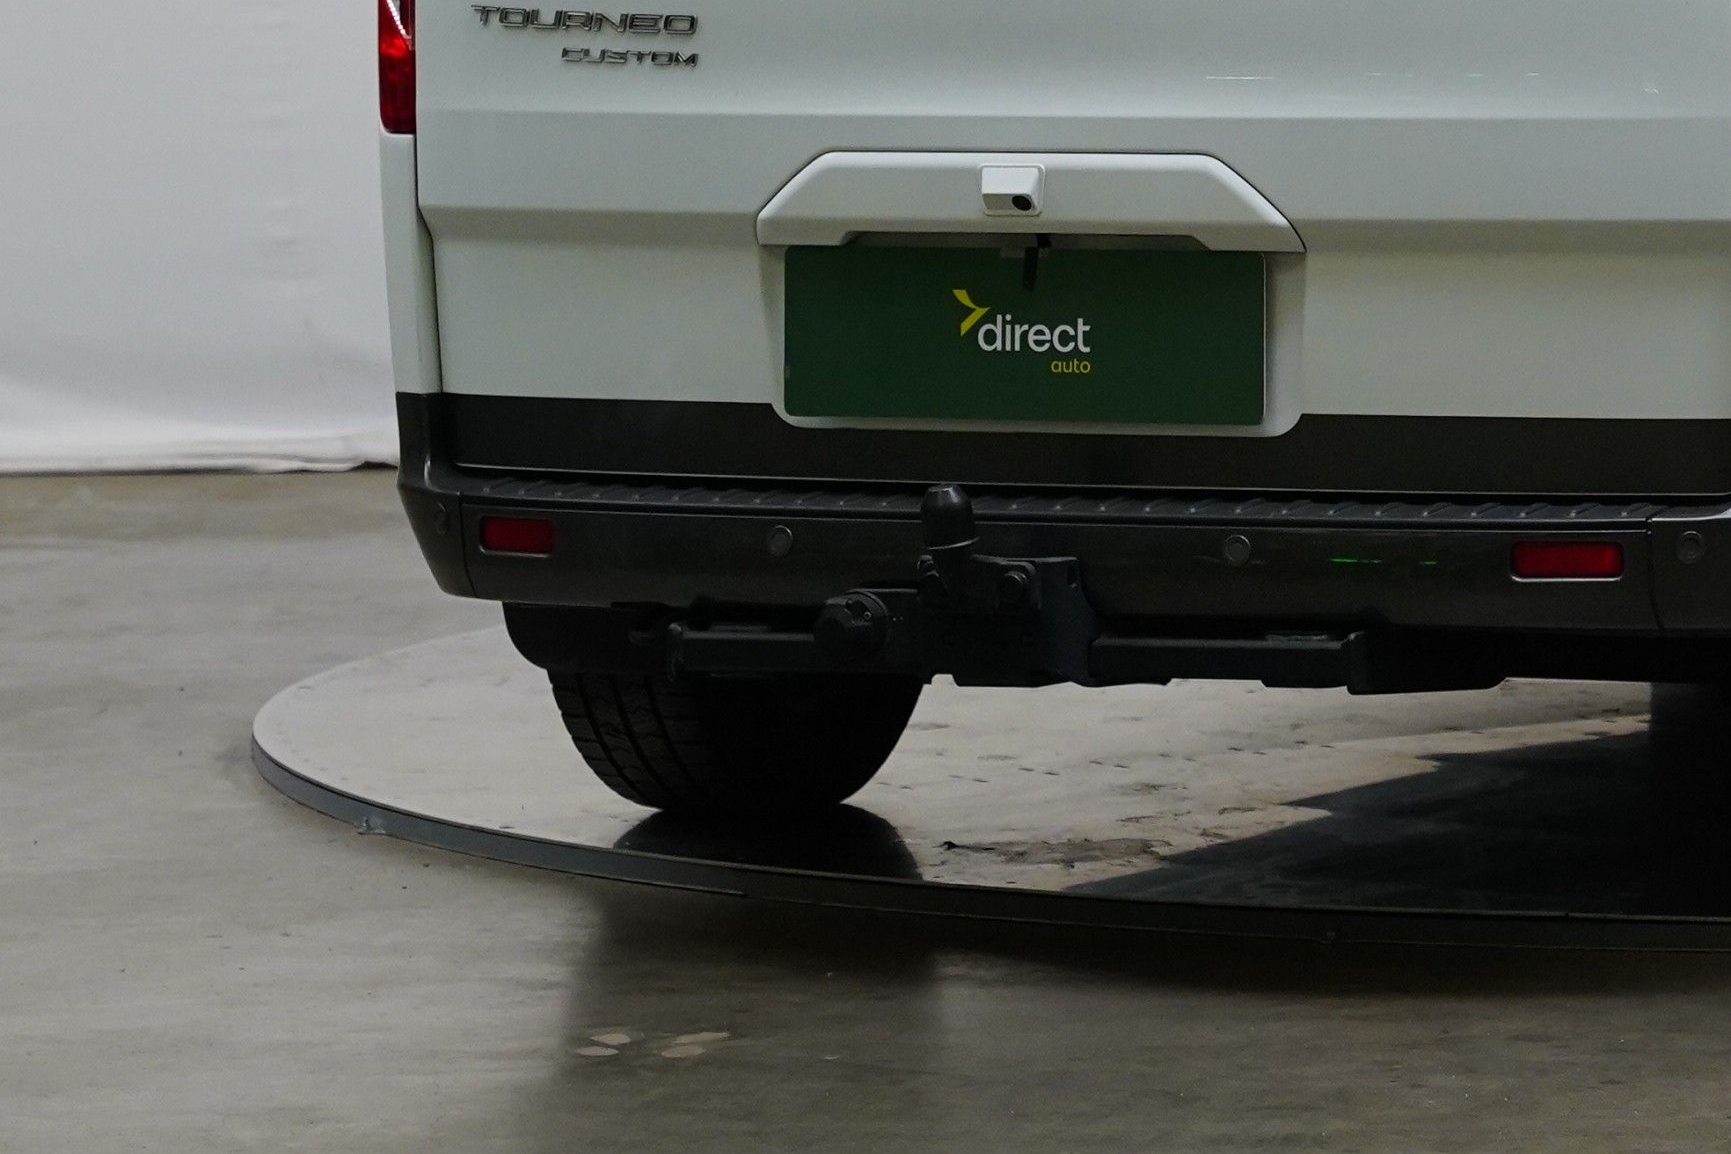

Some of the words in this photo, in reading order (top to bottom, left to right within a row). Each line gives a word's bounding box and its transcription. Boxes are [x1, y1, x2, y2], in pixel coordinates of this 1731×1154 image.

[470, 4, 699, 35] TOURNEO
[560, 46, 700, 68] CUSTOM
[977, 313, 1092, 354] direct
[1050, 357, 1092, 374] auto
